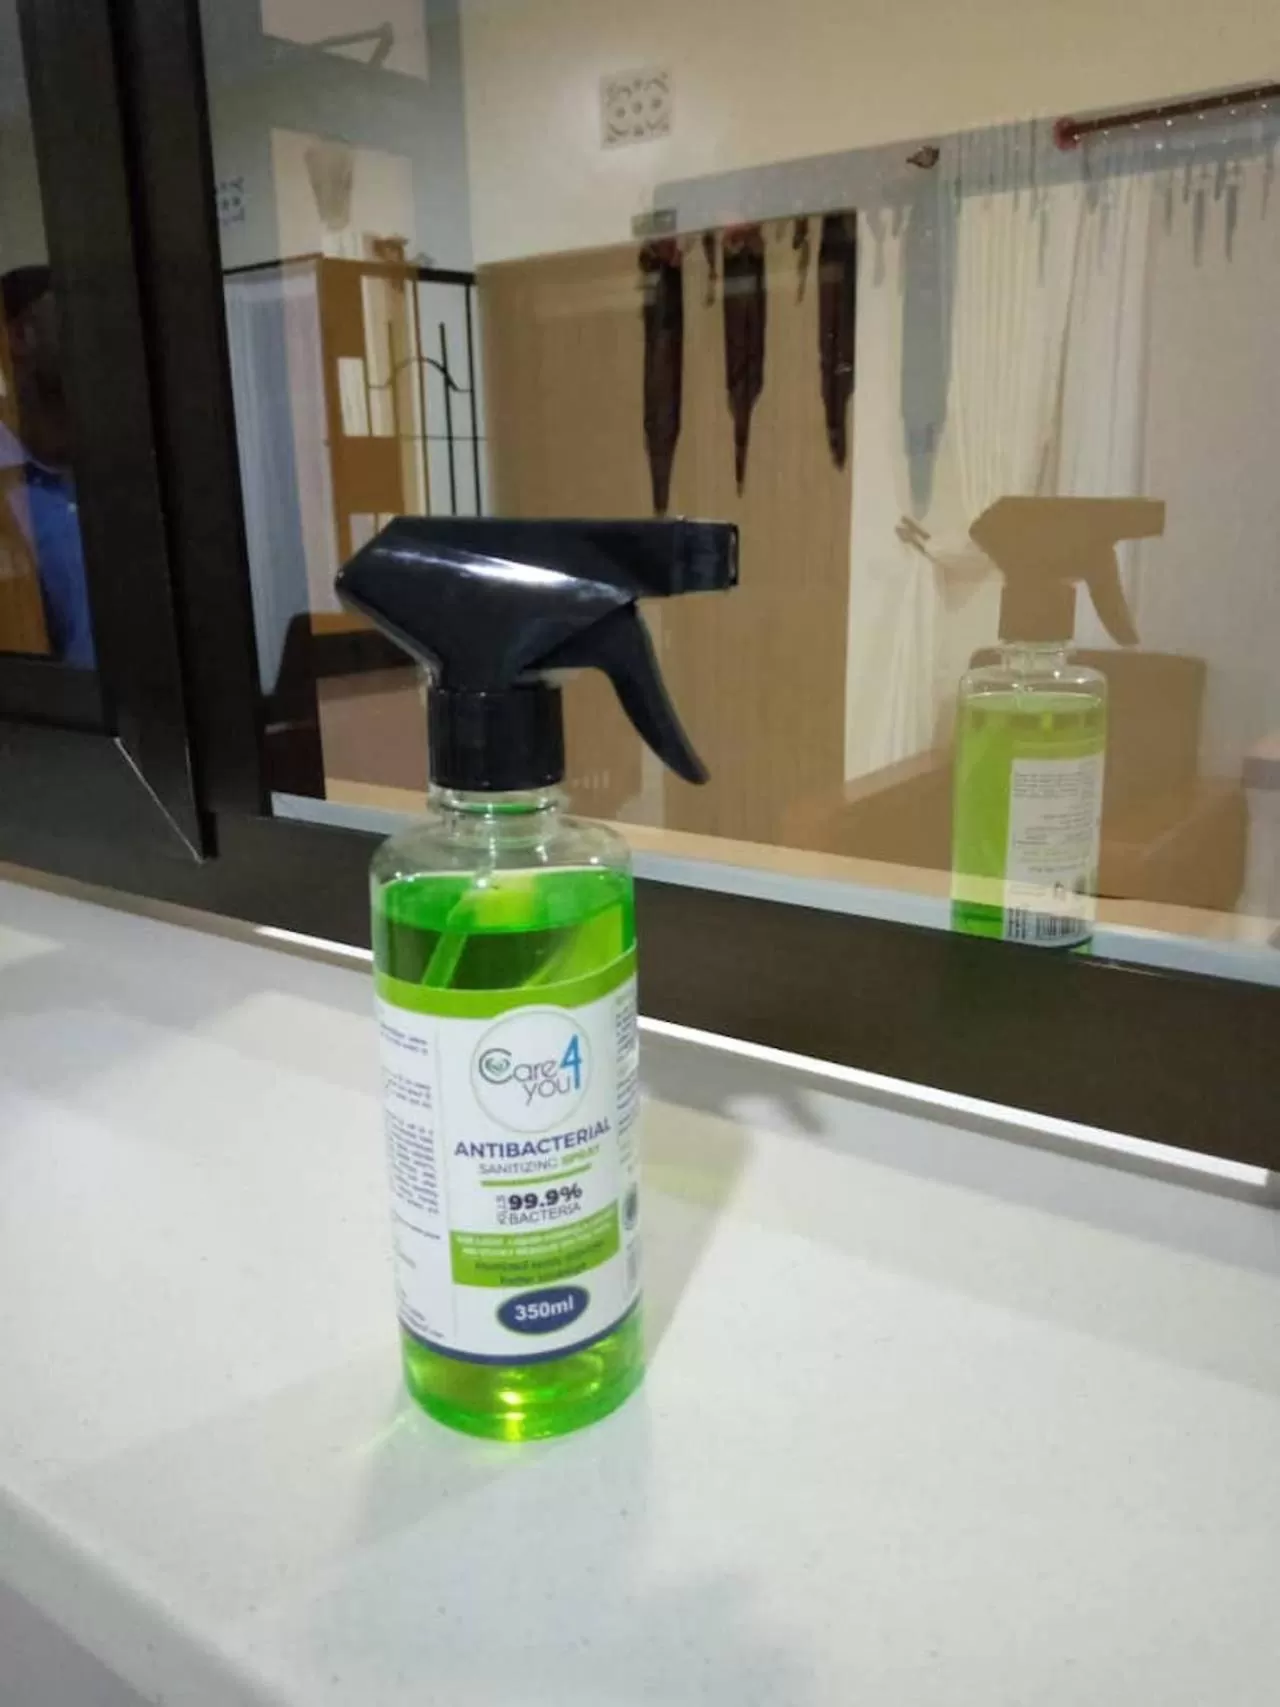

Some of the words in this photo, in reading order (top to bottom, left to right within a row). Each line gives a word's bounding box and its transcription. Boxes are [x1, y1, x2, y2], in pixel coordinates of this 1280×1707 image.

[478, 1048, 557, 1085] Care
[560, 1033, 583, 1090] 4
[523, 1076, 571, 1107] you
[453, 1116, 612, 1159] ANTIBACTERIAL
[479, 1156, 559, 1175] SANITIZING
[508, 1182, 583, 1212] 99.9%
[509, 1202, 582, 1226] BACTERIA
[514, 1293, 574, 1322] 350ml
